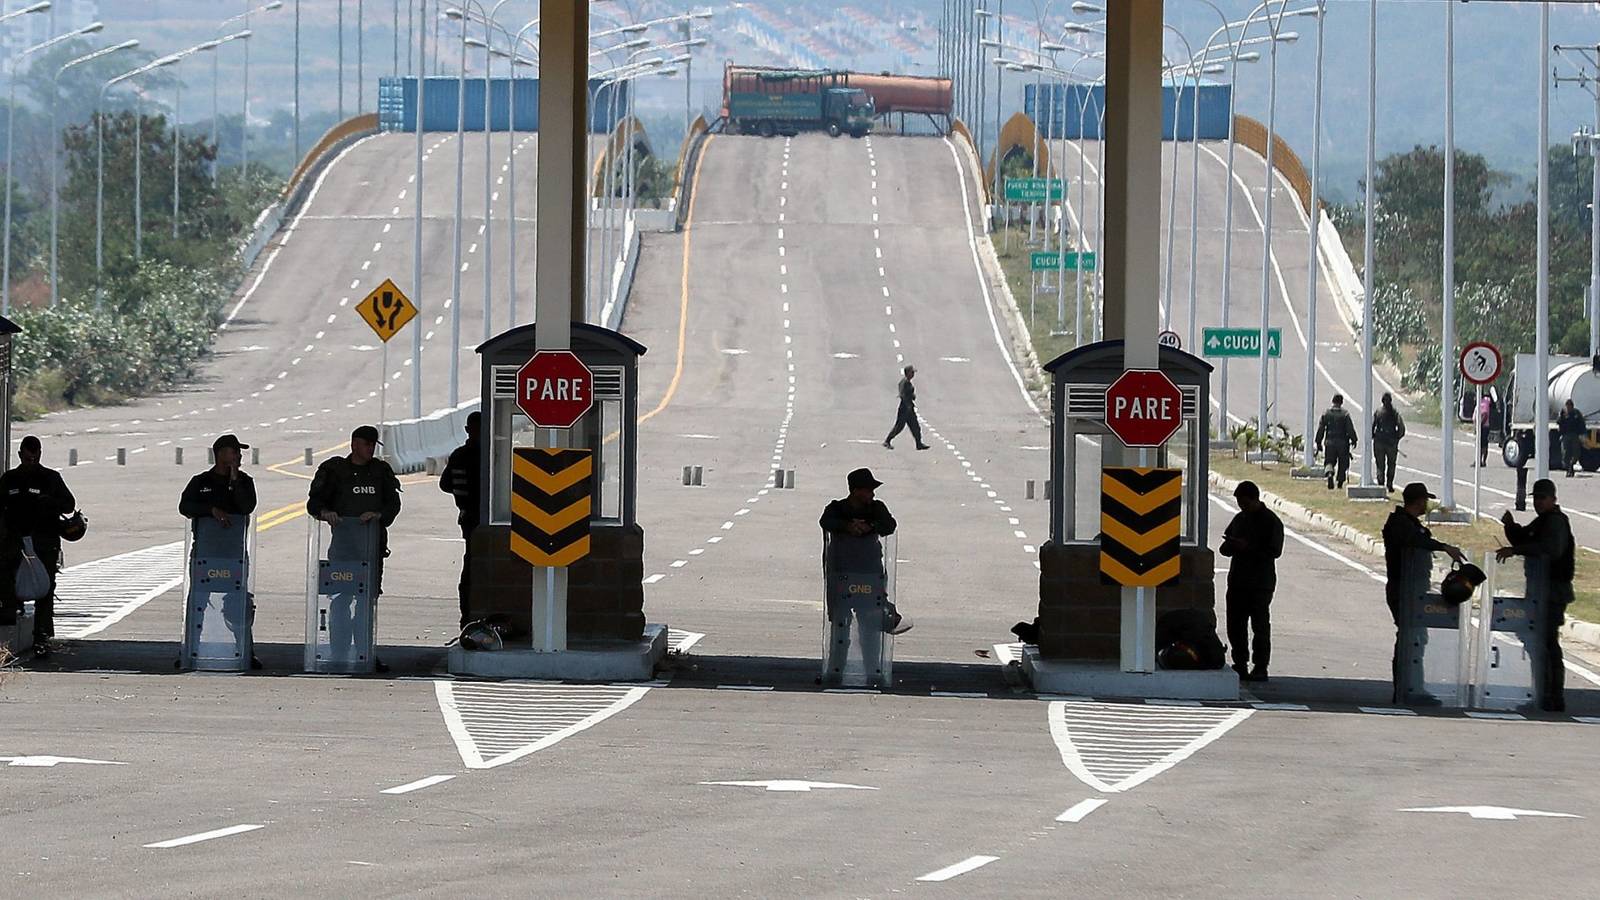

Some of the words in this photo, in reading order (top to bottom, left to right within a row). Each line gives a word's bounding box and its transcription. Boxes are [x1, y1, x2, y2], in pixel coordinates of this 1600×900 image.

[1160, 335, 1176, 345] 40
[1223, 335, 1276, 351] CUCUA
[526, 377, 583, 401] PARE
[1114, 396, 1172, 420] PARE
[352, 486, 376, 494] GNB
[207, 569, 231, 578] GNB
[330, 571, 353, 581] GNB
[848, 584, 872, 593] GNB
